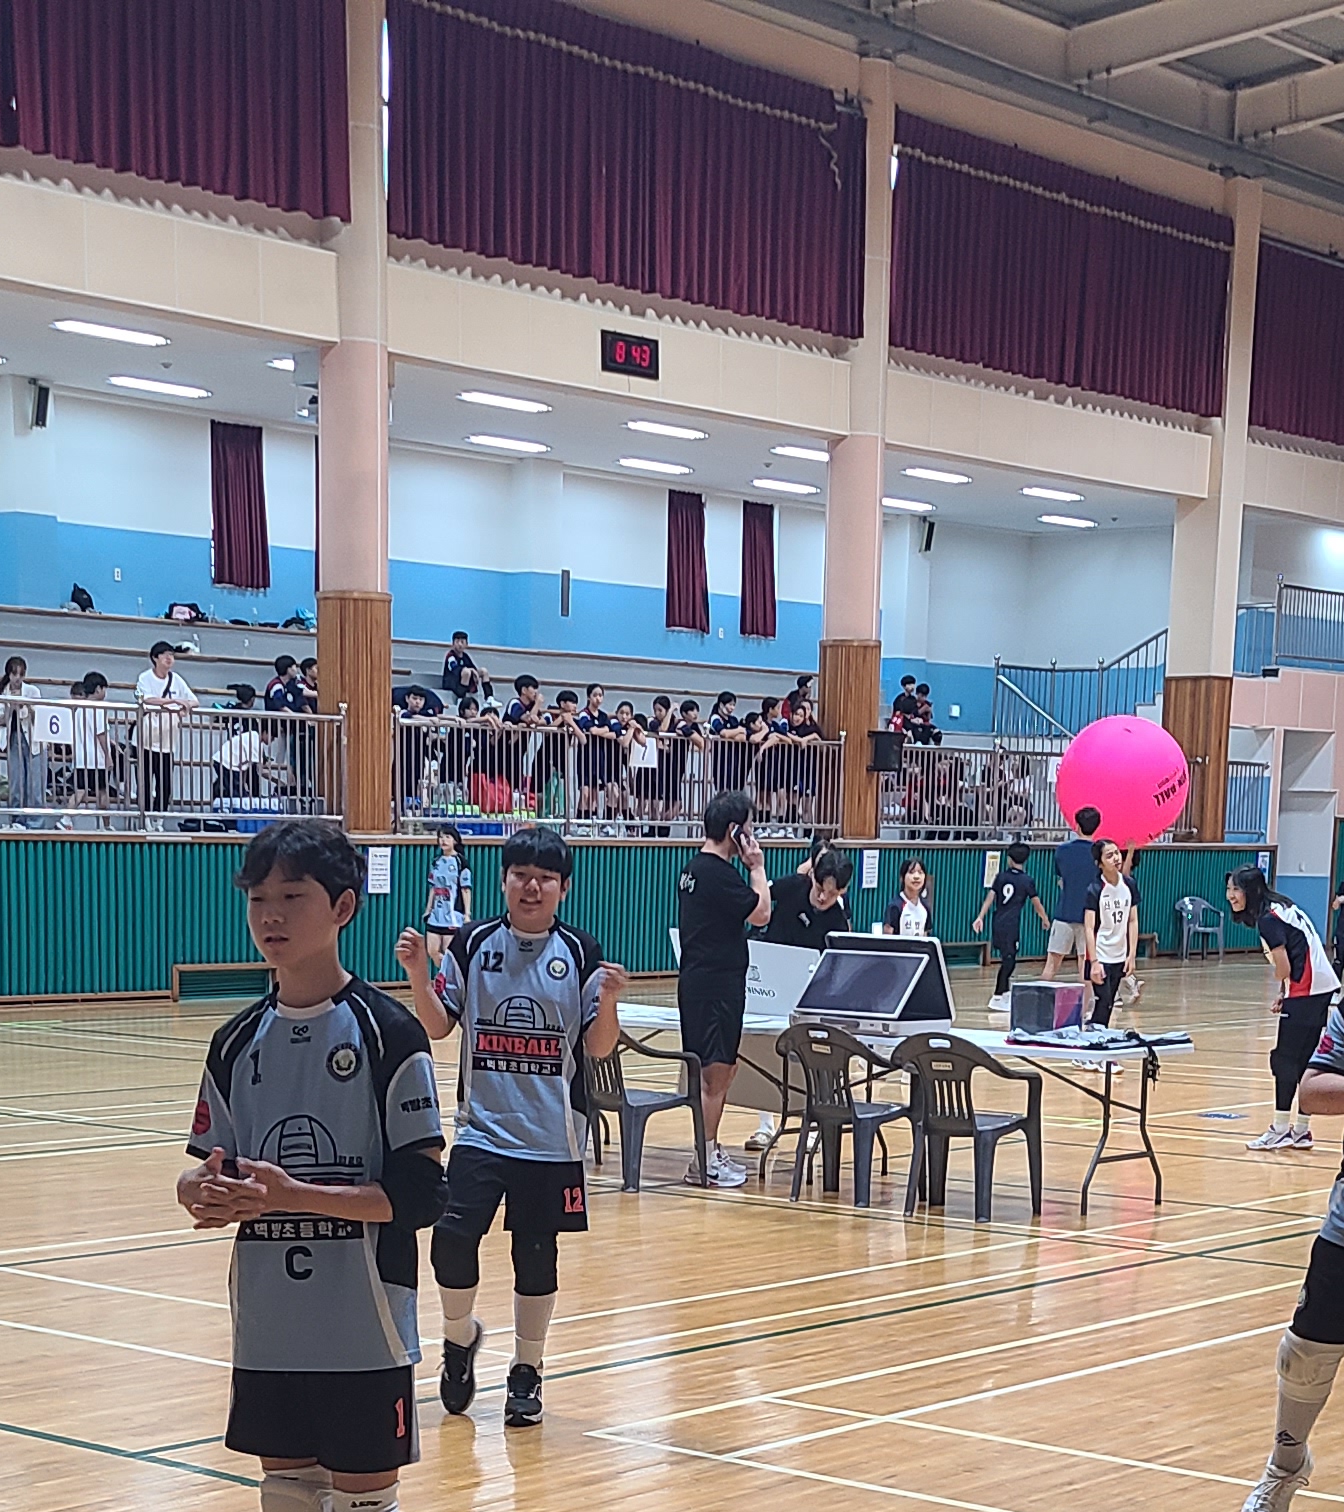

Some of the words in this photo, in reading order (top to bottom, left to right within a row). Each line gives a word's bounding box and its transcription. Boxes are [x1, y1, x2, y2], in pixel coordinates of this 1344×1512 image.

[48, 715, 61, 736] 6
[1002, 883, 1015, 905] 9
[1111, 910, 1124, 924] 13
[480, 950, 505, 973] 12
[477, 1032, 561, 1057] KINBALL
[249, 1048, 262, 1086] 1
[563, 1187, 584, 1213] 12
[253, 1221, 348, 1239] 벽방초등학교
[284, 1246, 313, 1281] C
[394, 1397, 406, 1438] 1
